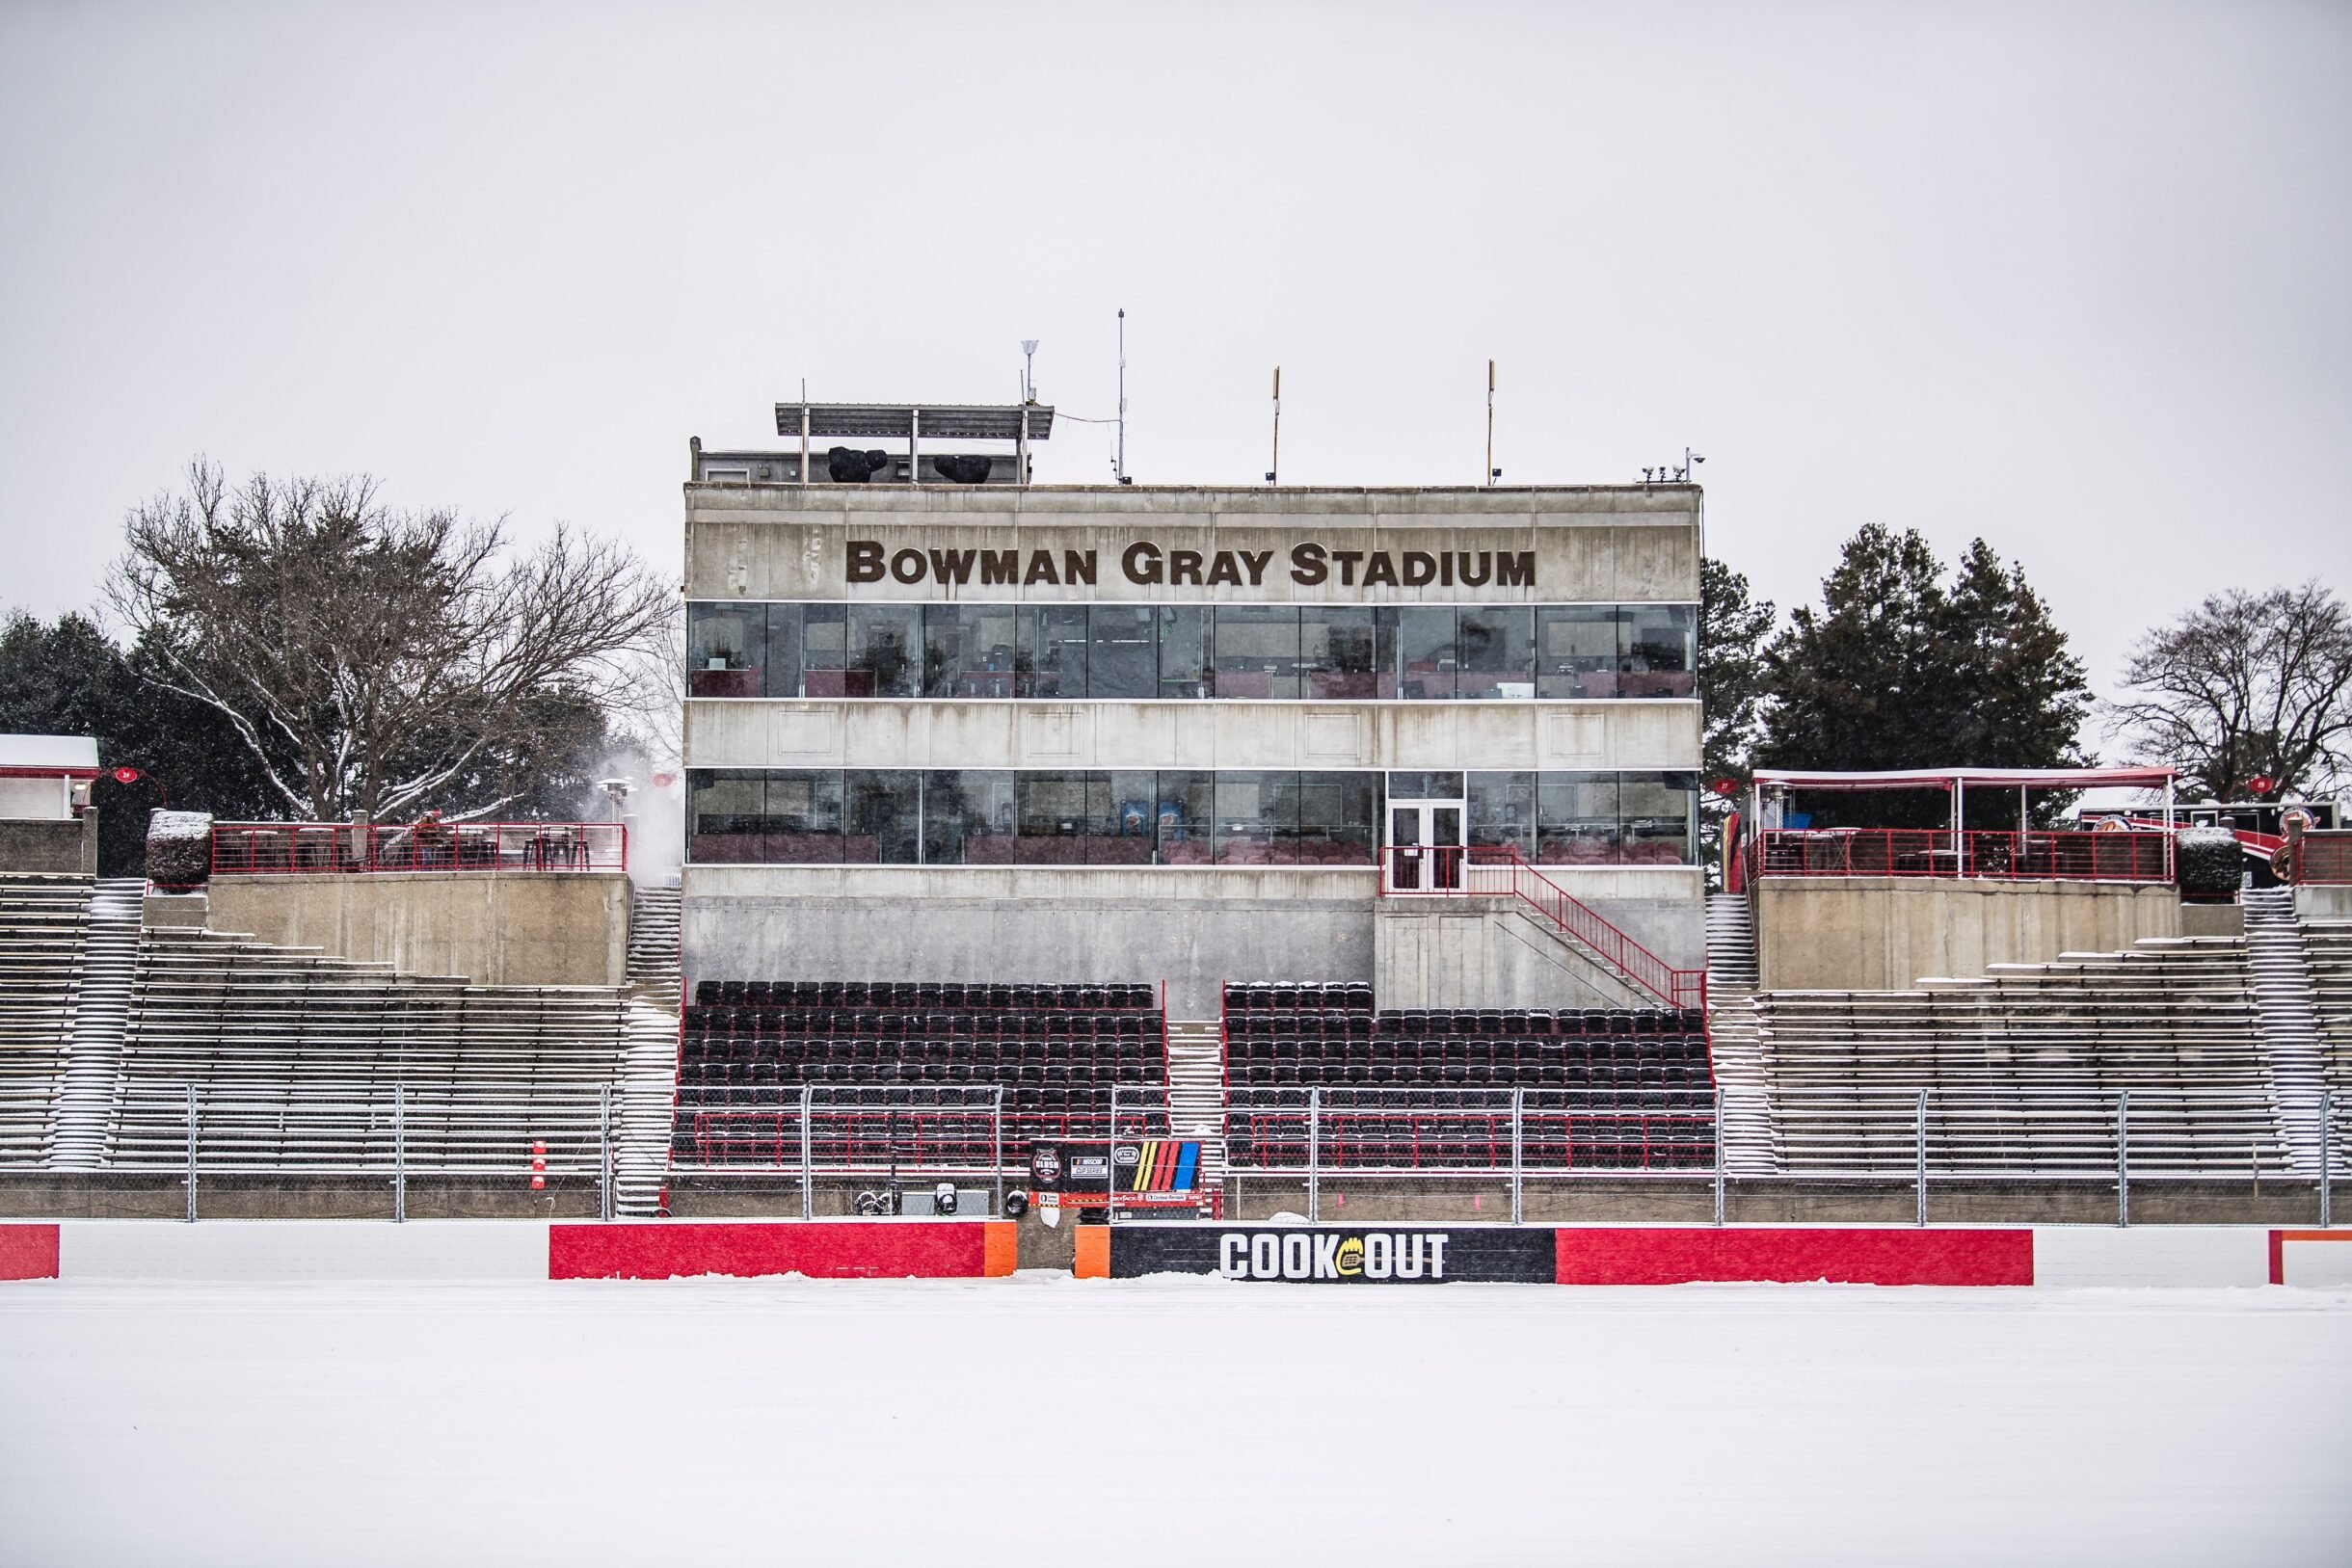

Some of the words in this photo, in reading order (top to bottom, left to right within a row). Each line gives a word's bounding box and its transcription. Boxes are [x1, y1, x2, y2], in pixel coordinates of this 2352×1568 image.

[846, 541, 1097, 585] BOWMAN
[1121, 541, 1274, 586] GRAY
[1290, 542, 1536, 587] STADIUM
[1035, 1160, 1059, 1169] CLASH
